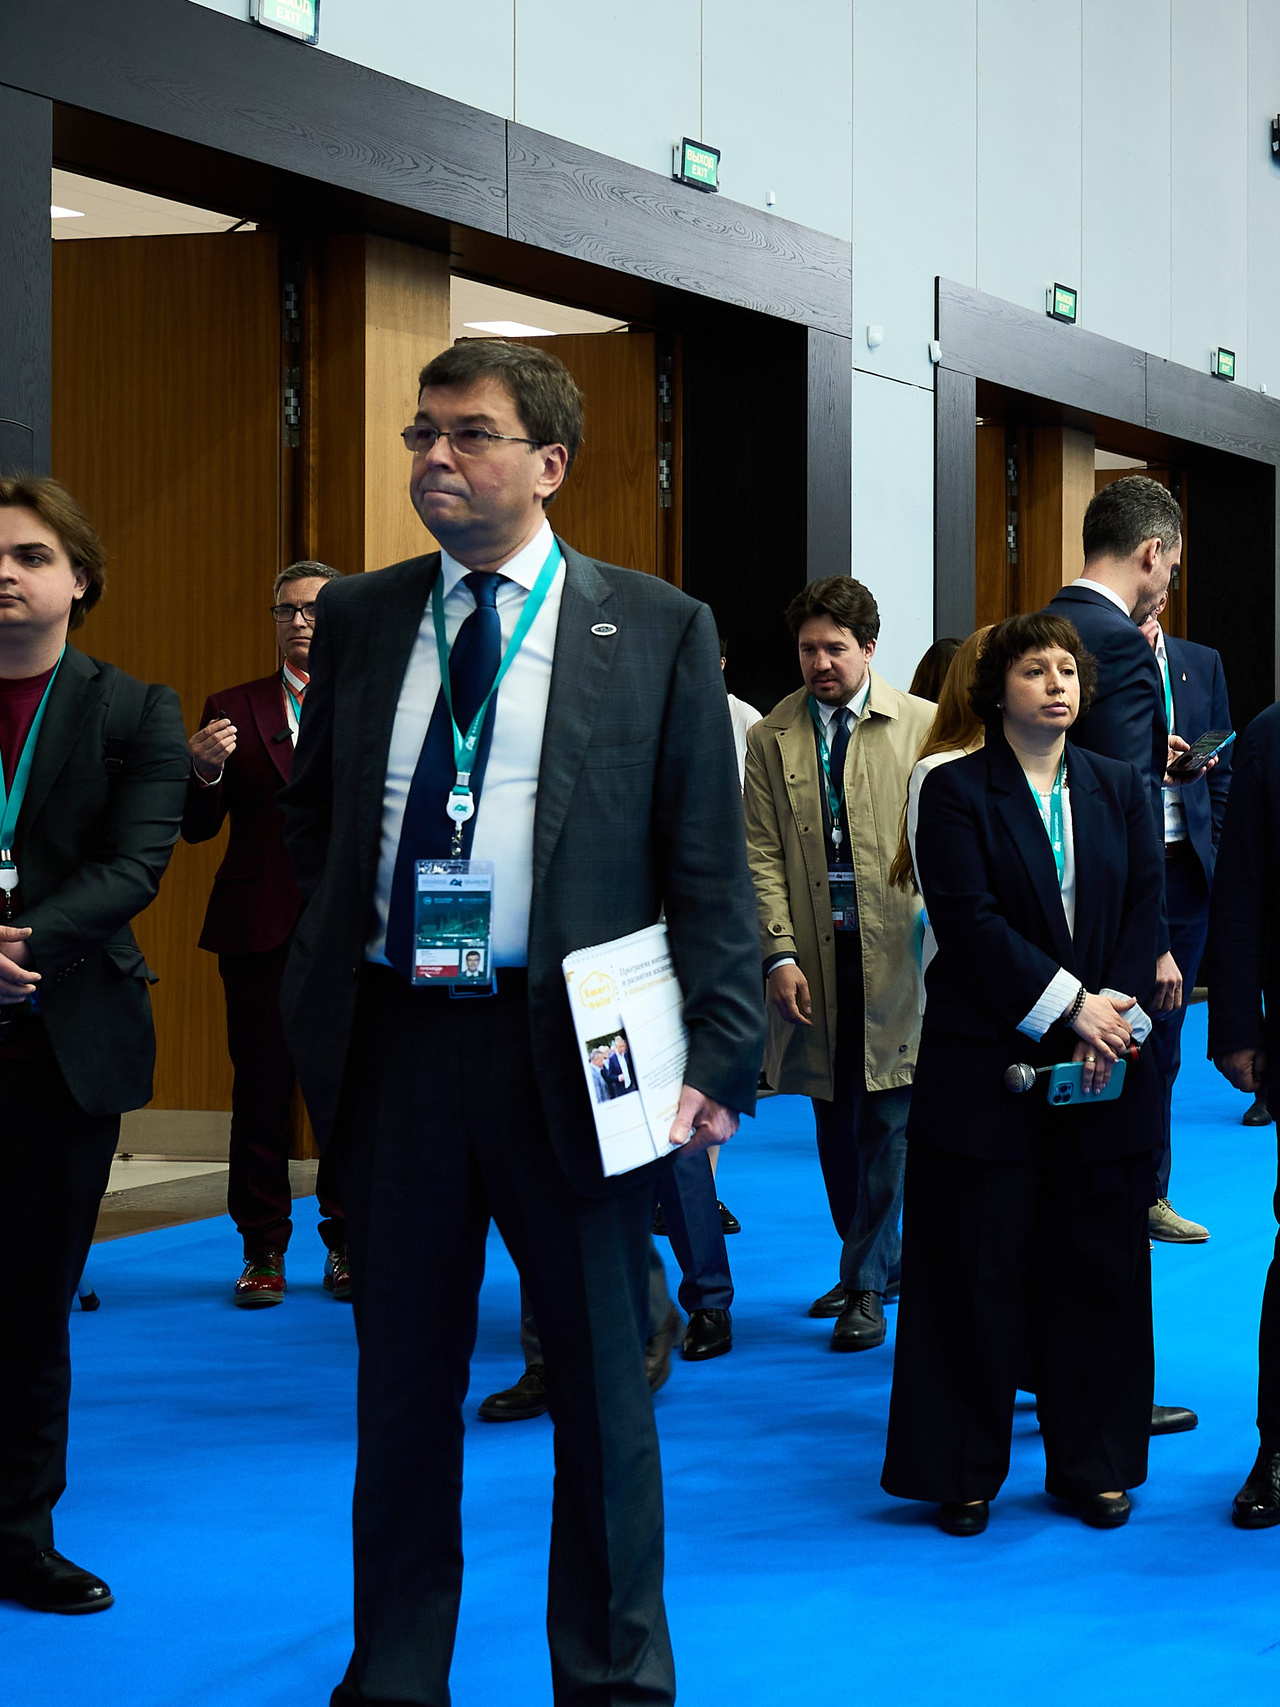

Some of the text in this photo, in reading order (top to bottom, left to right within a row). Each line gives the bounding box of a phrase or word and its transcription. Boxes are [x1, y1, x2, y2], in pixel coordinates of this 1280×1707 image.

[276, 6, 301, 25] EXIT
[687, 149, 715, 171] ВЫХОД
[691, 164, 709, 179] EXIT
[585, 983, 610, 998] Smart
